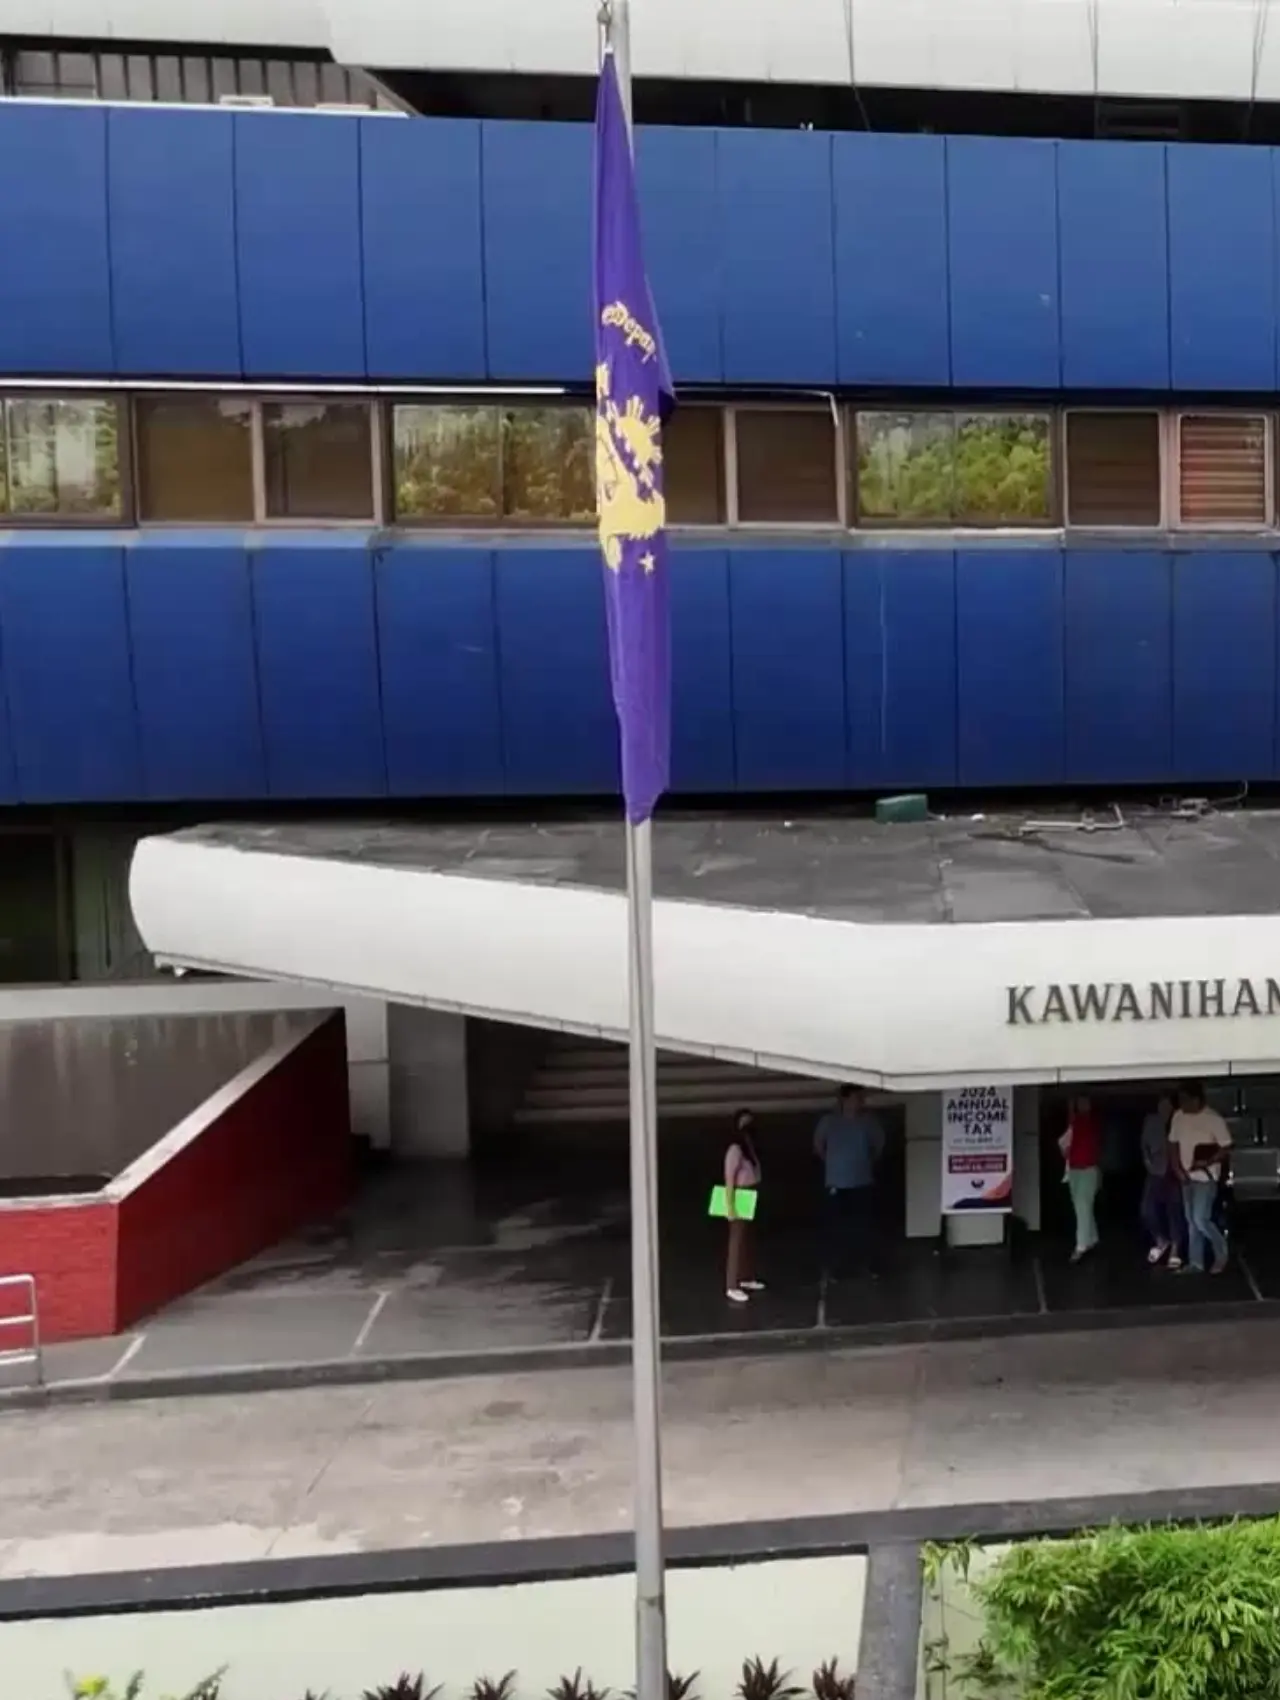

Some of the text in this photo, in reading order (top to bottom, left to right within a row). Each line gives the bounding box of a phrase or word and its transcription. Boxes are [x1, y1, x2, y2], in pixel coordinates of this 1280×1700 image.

[960, 1086, 997, 1098] 2024
[947, 1099, 1009, 1110] ANNUAL
[948, 1111, 1008, 1123] INCOME
[964, 1123, 993, 1135] TAX
